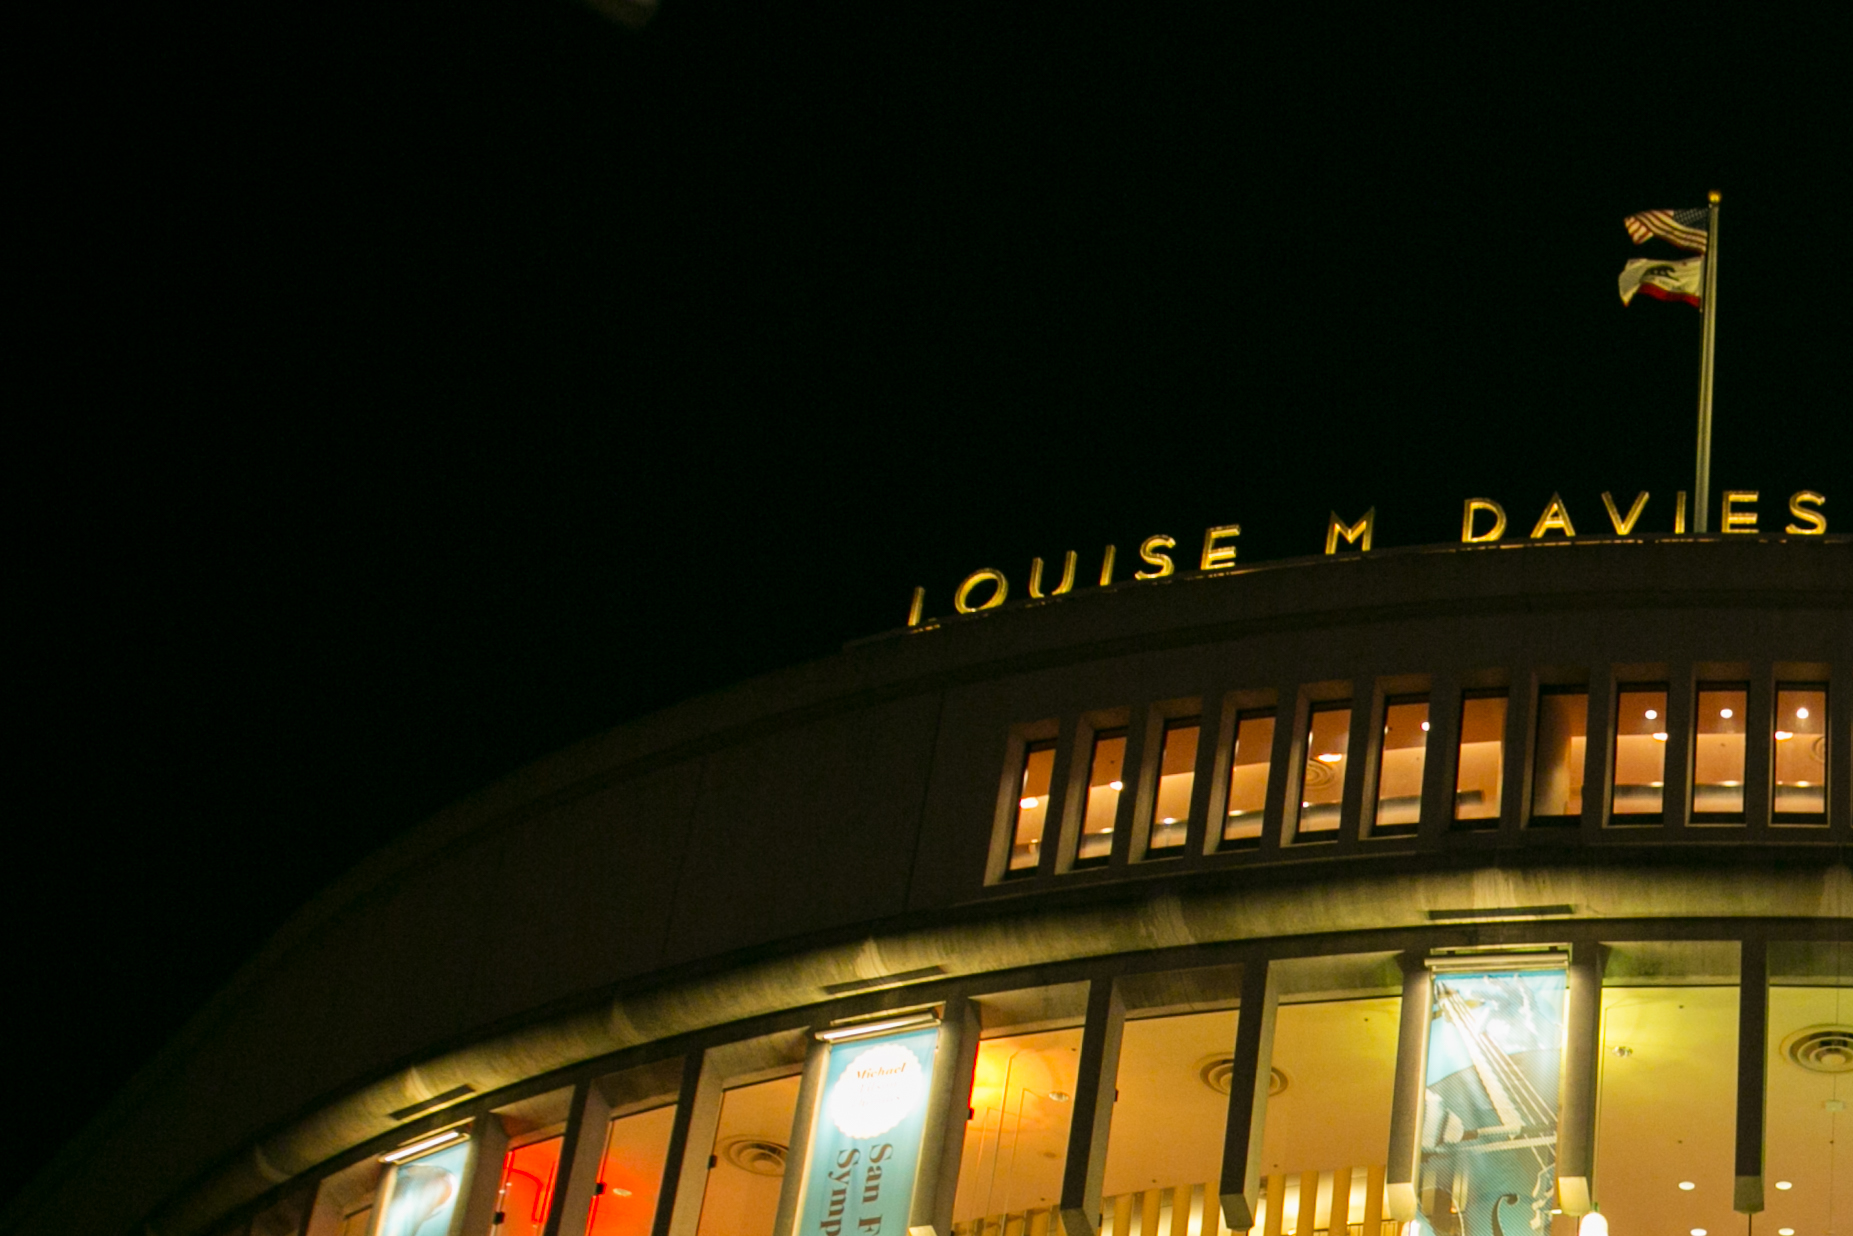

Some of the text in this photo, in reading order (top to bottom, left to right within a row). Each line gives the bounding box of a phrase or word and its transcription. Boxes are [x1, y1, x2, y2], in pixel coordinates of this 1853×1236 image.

[907, 523, 1243, 628] LOUISE
[1324, 506, 1377, 555] M
[1461, 490, 1829, 543] DAVIES
[856, 1062, 907, 1080] Michael
[862, 1142, 894, 1204] San
